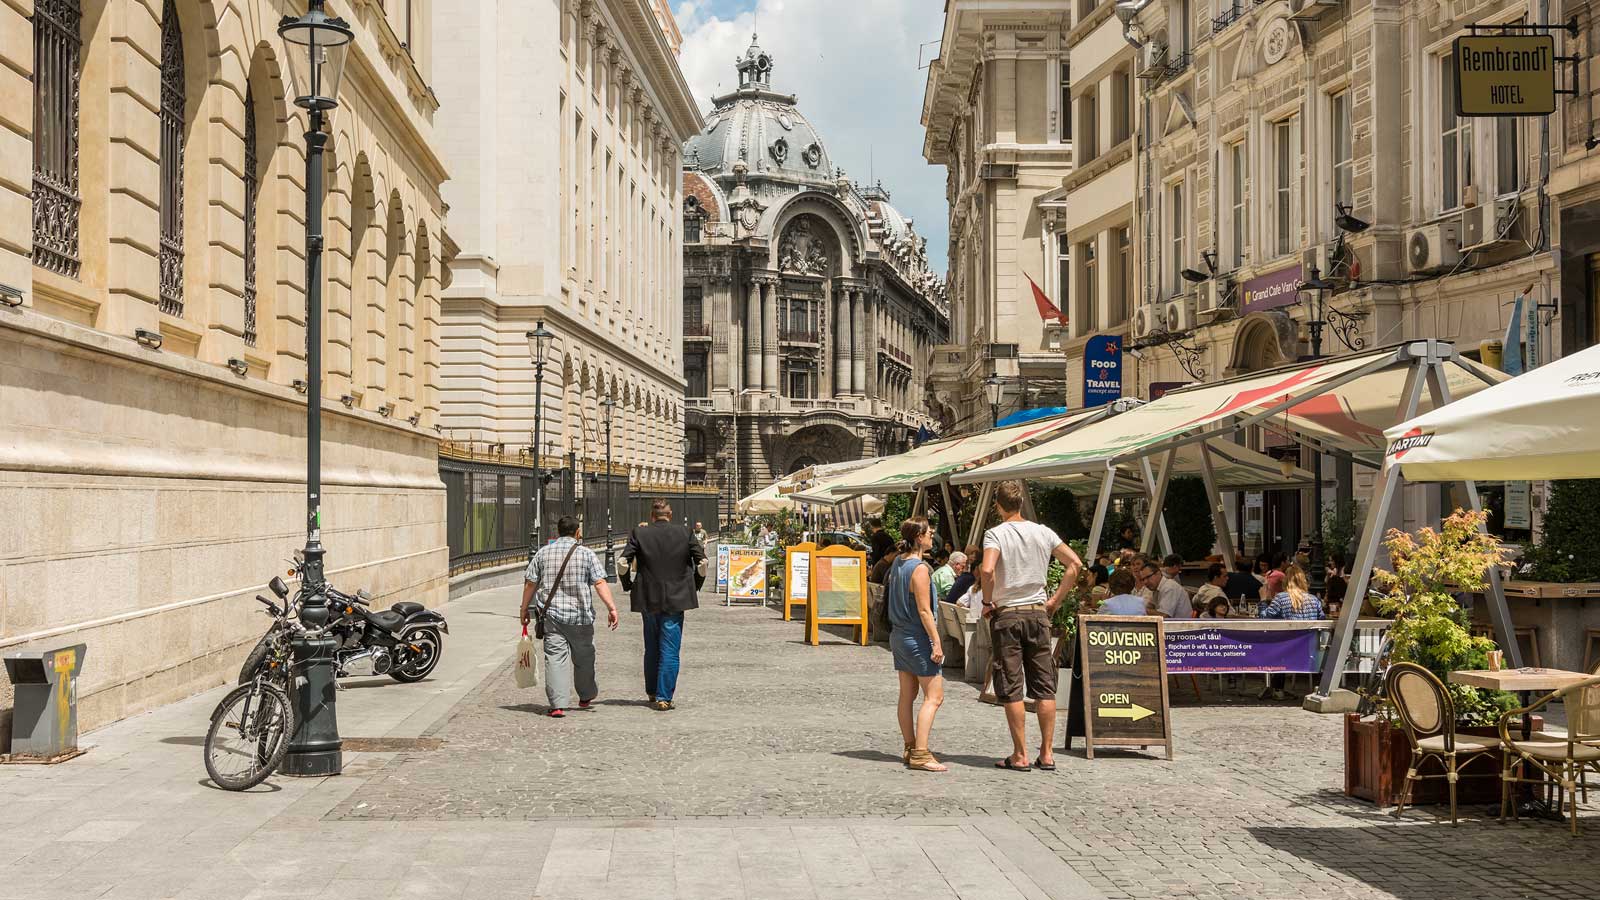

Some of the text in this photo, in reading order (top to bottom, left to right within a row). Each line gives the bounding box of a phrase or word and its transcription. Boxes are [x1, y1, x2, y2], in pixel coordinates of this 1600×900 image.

[1490, 85, 1524, 104] HOTEL
[1252, 288, 1269, 301] Grand
[1282, 281, 1293, 293] Van
[1099, 369, 1108, 379] &
[1089, 631, 1155, 646] SOUVENIR
[1105, 650, 1141, 664] SHOP
[1099, 693, 1130, 704] OPEN
